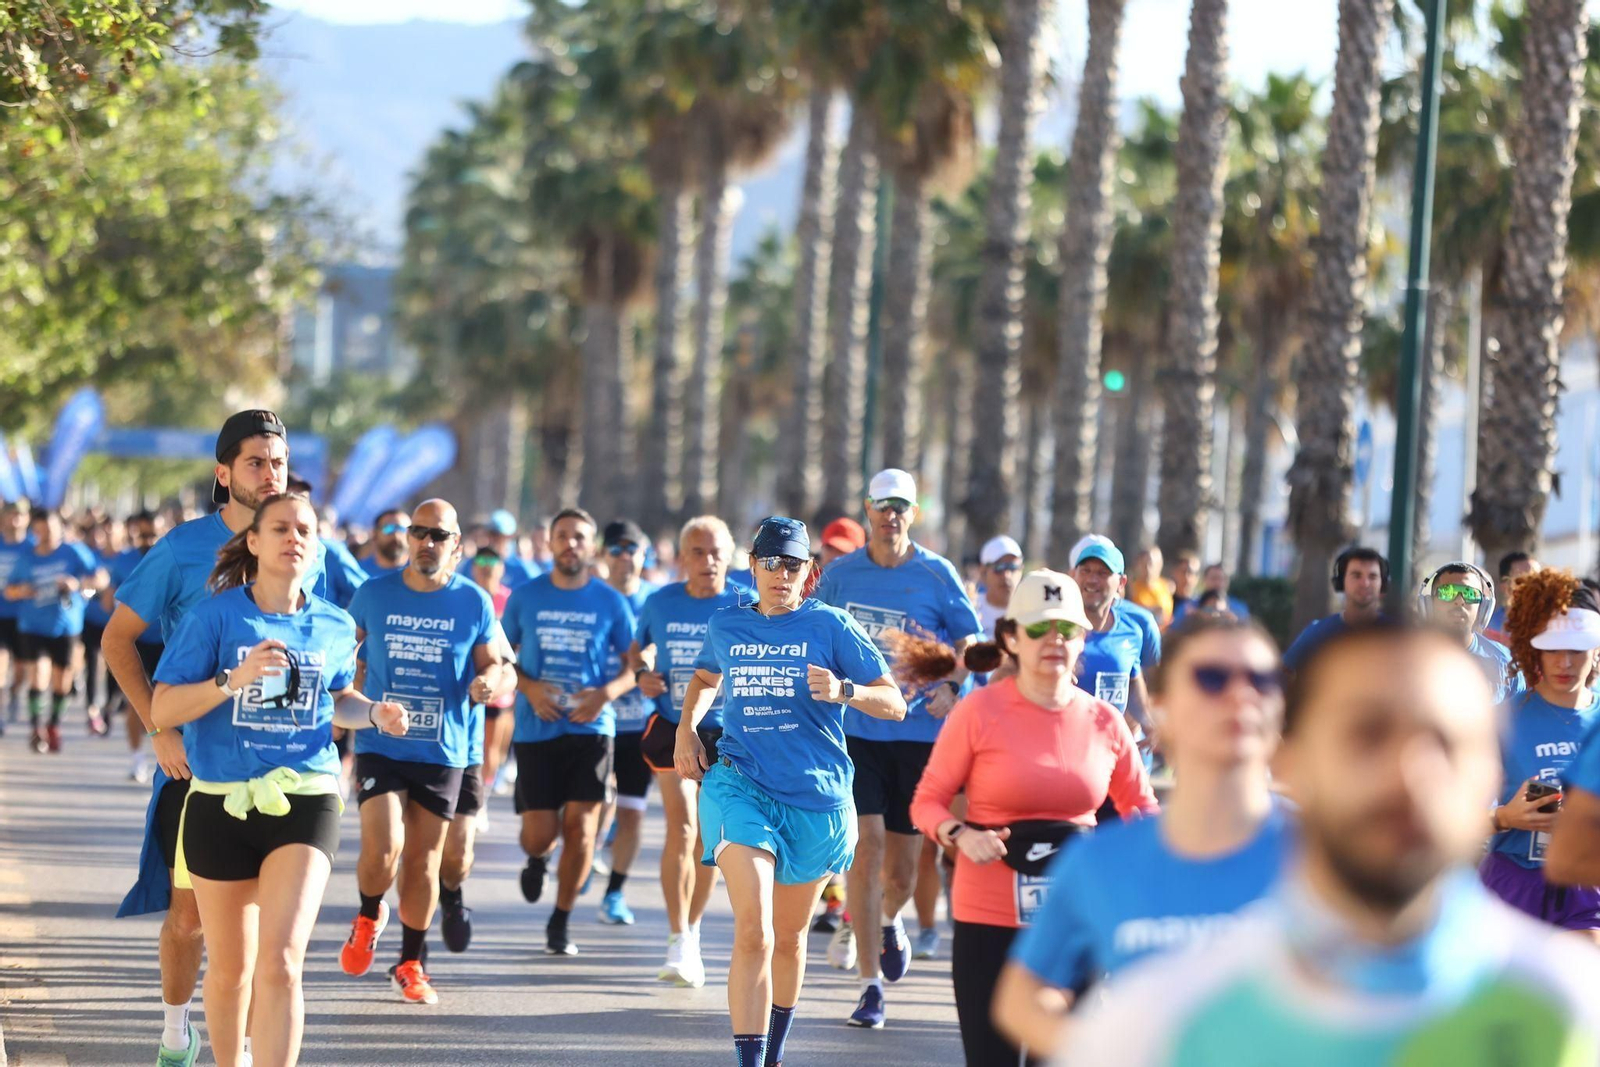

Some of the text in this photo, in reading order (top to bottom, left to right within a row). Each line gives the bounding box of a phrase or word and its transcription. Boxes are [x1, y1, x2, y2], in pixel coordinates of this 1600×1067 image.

[1043, 585, 1062, 601] M
[386, 614, 455, 631] mayoral
[666, 622, 708, 636] mayo
[729, 642, 808, 659] mayoral
[729, 665, 801, 677] RUNNING
[734, 676, 794, 687] MAKES
[732, 686, 796, 697] FRIENDS
